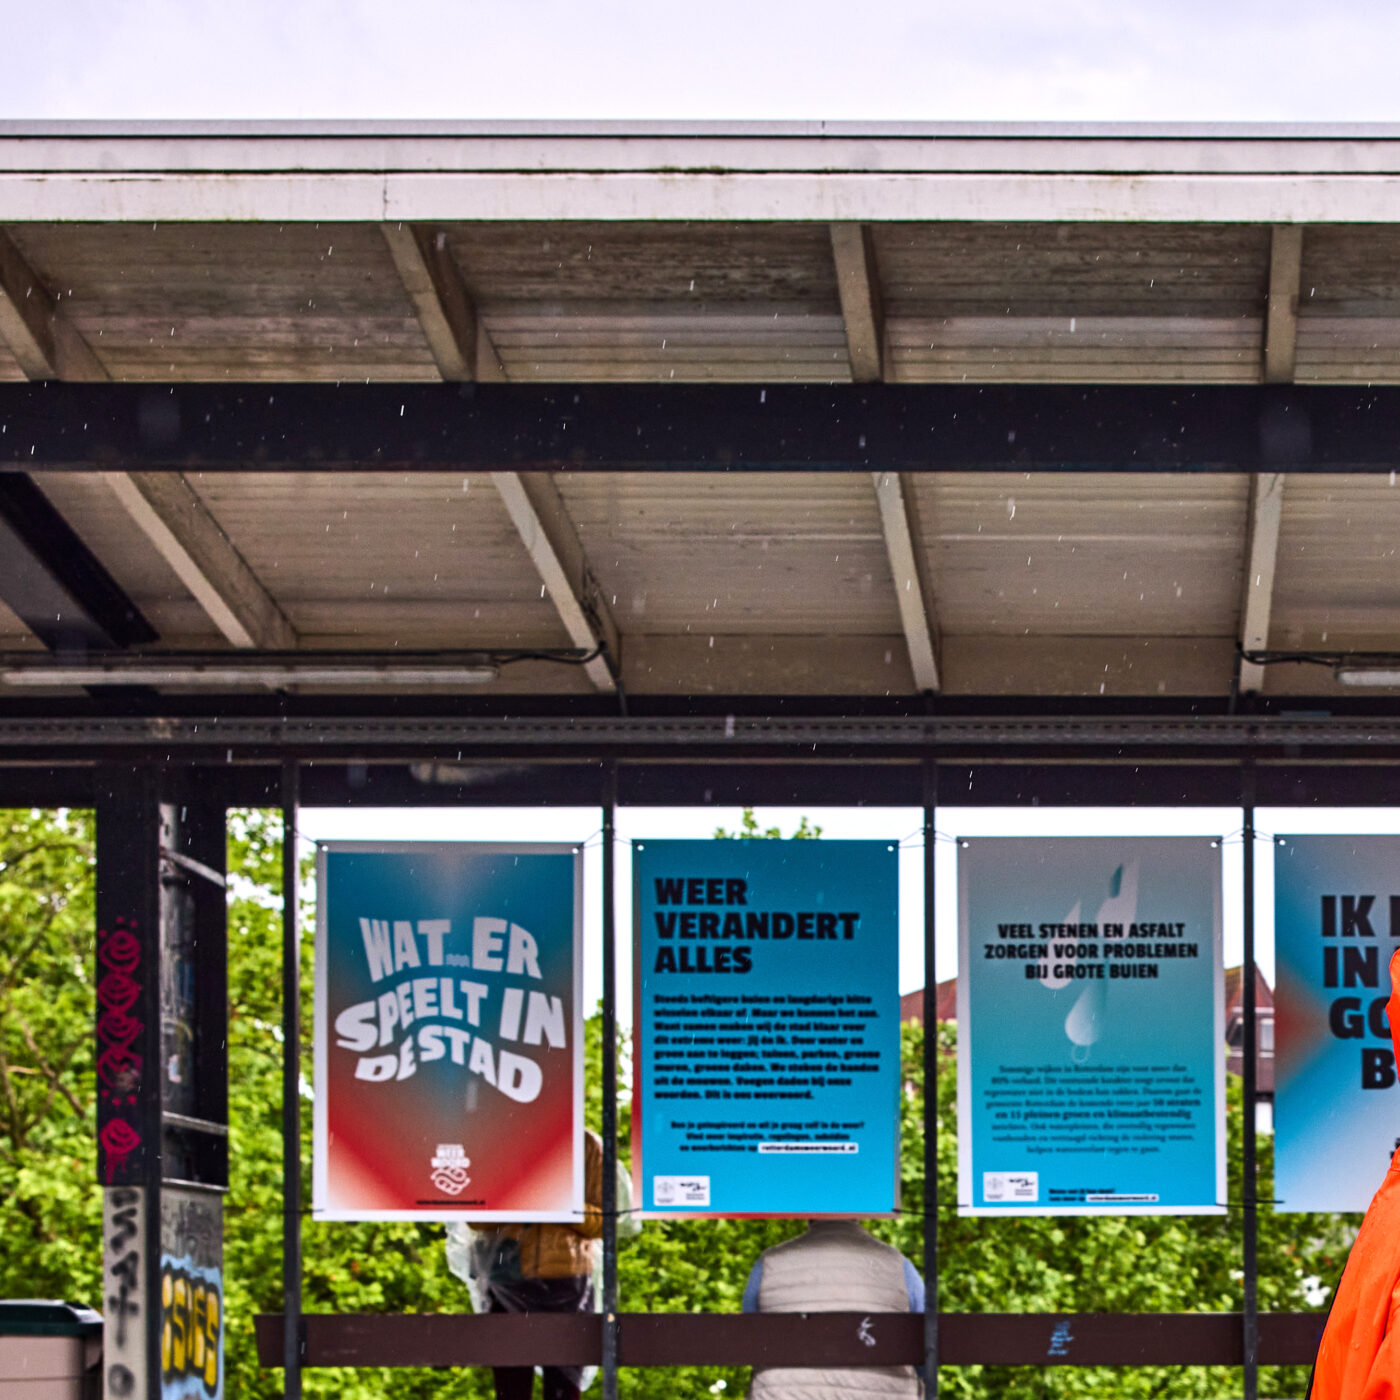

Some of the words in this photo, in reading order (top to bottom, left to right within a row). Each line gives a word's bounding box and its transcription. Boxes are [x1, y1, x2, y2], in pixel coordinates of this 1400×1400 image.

[654, 878, 748, 906] WEER
[654, 912, 859, 940] VERANDERT
[1321, 895, 1376, 937] IK
[997, 924, 1035, 939] VEEL
[1039, 923, 1099, 939] STENEN
[1103, 923, 1123, 938] EN
[1128, 923, 1185, 938] ASFALT
[359, 917, 451, 983] WAT
[472, 917, 543, 979] ER
[654, 946, 753, 974] ALLES
[984, 943, 1049, 959] ZORGEN
[1053, 943, 1098, 959] VOOR
[1103, 943, 1198, 959] PROBLEMEN
[1025, 964, 1048, 980] BIJ
[1053, 963, 1105, 979] GROTE
[1109, 964, 1158, 979] BUIEN
[1324, 946, 1379, 988] IN
[334, 978, 489, 1052] SPEELT
[500, 988, 567, 1049] IN
[355, 1036, 417, 1082] DE
[418, 1025, 543, 1104] STAD
